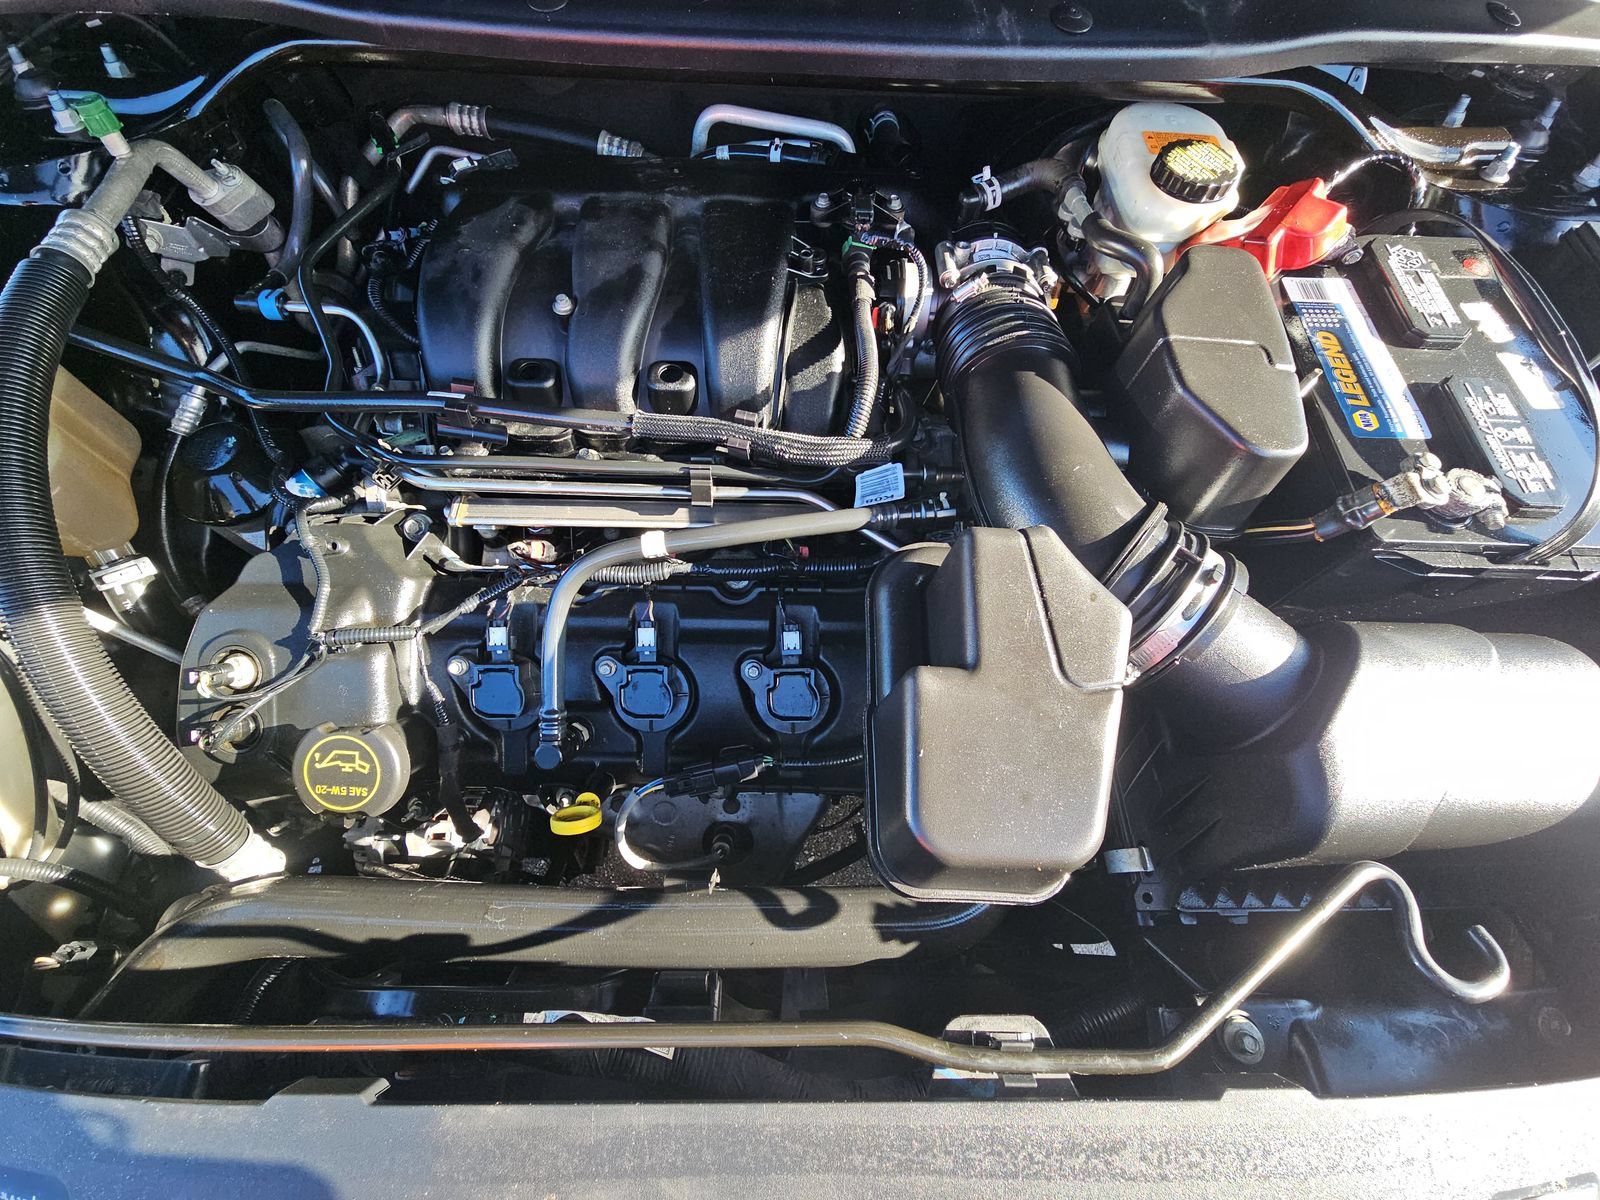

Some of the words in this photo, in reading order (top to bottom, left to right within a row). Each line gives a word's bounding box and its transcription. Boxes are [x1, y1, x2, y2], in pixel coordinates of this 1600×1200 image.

[1316, 330, 1371, 407] LEGEND
[1359, 412, 1374, 428] NAPA
[315, 784, 347, 795] 5W-20
[349, 786, 368, 797] SAE
